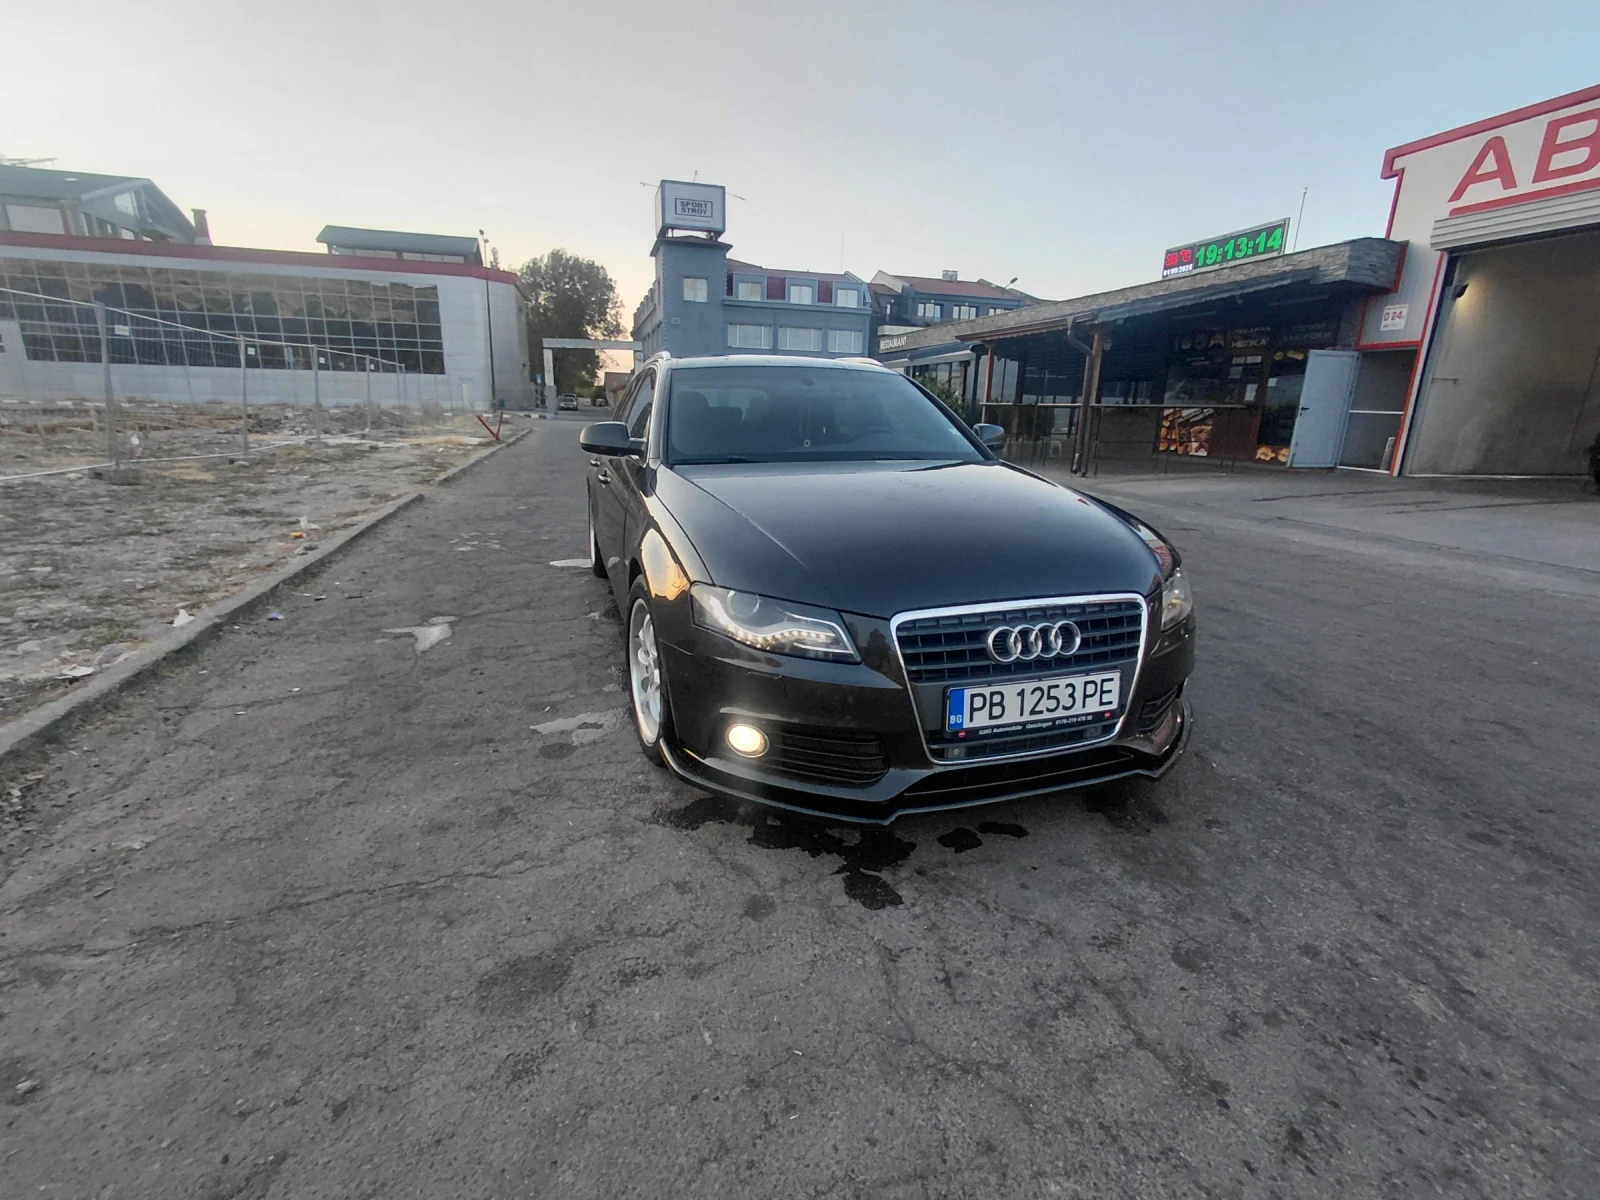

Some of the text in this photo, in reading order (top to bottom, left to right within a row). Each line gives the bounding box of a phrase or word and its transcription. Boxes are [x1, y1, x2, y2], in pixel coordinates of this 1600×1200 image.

[680, 201, 708, 209] SPORT
[681, 207, 708, 215] STROY
[1196, 228, 1282, 267] 19:13:14
[969, 677, 1114, 722] PB 1253 PE
[950, 714, 963, 725] BG
